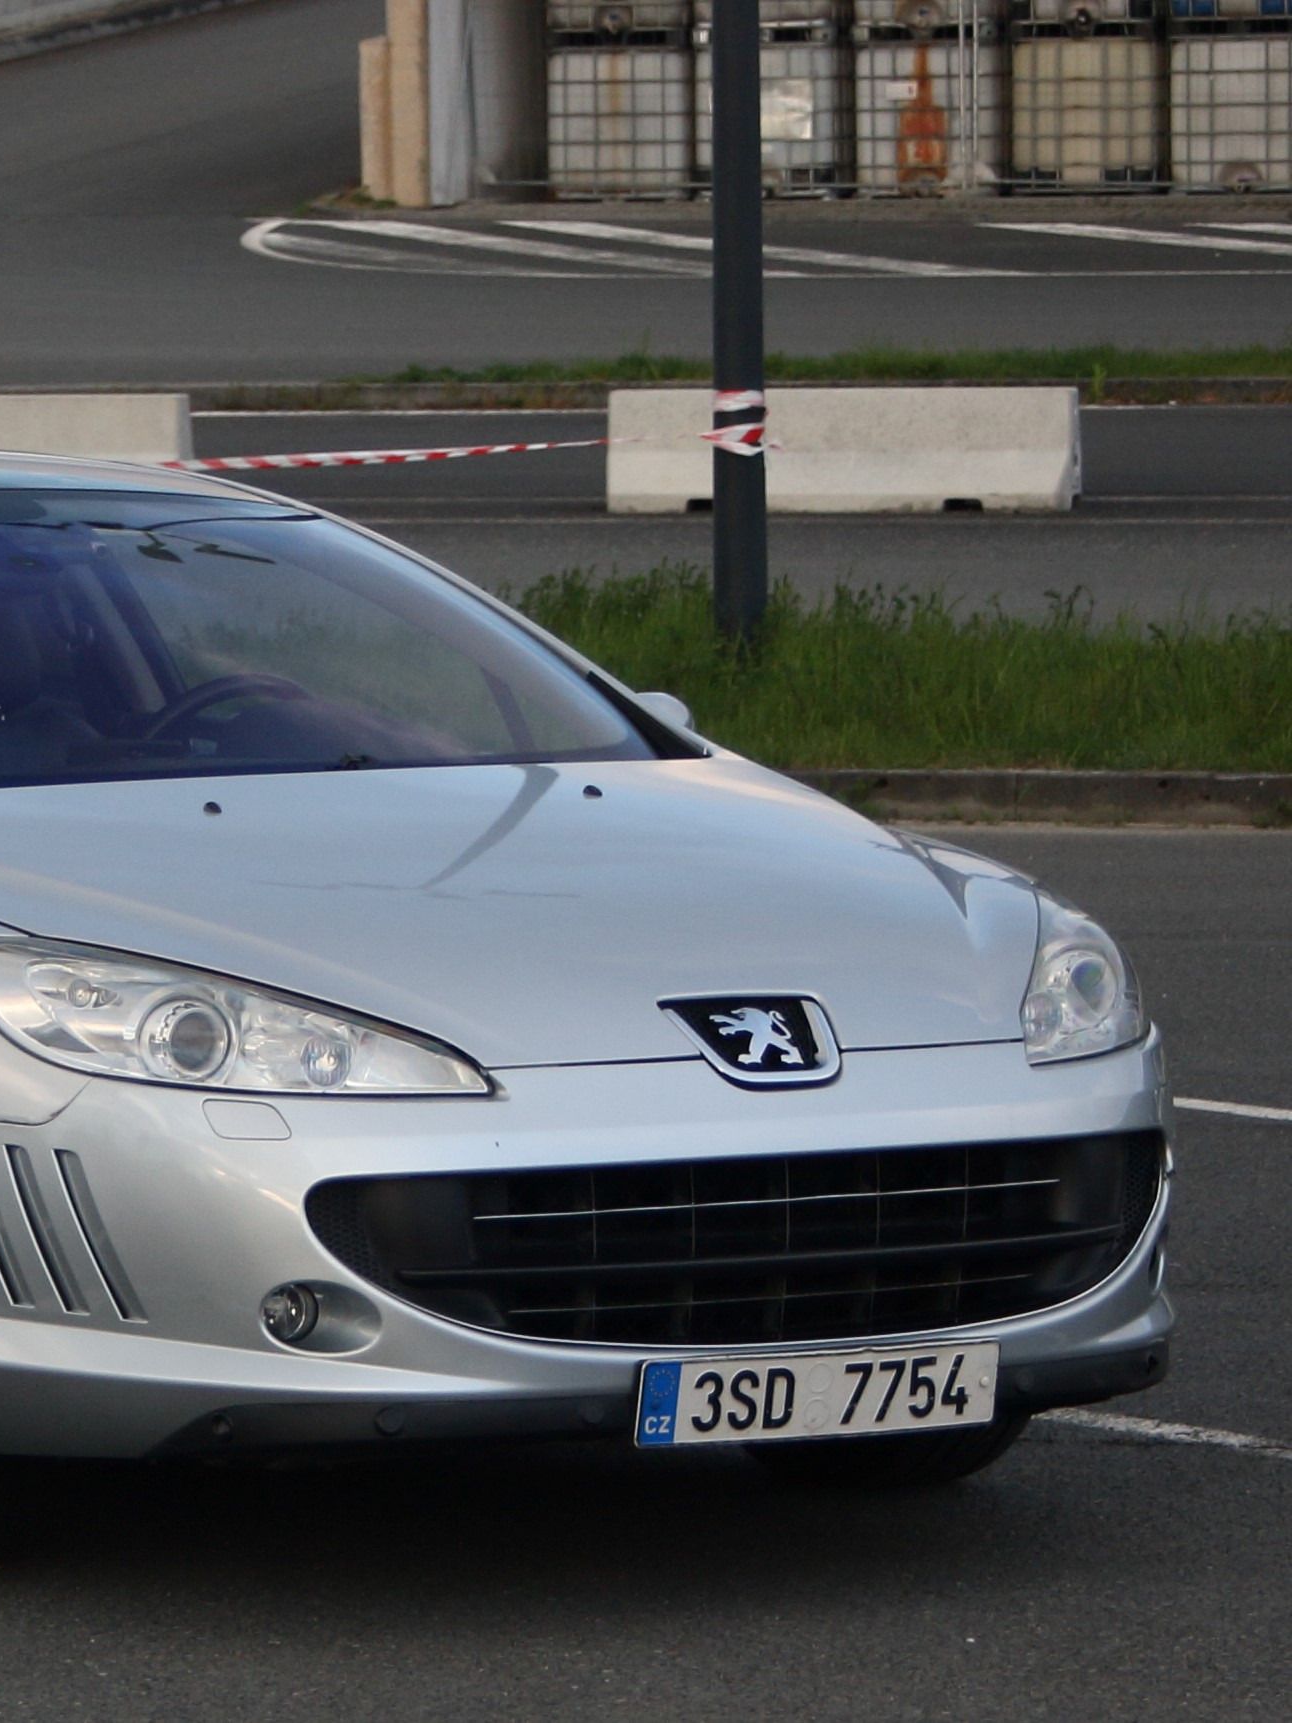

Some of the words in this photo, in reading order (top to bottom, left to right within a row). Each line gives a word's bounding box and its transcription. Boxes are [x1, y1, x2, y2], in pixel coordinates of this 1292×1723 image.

[691, 1367, 796, 1432] 3SD
[839, 1353, 969, 1425] 7754
[644, 1415, 670, 1434] CZ
